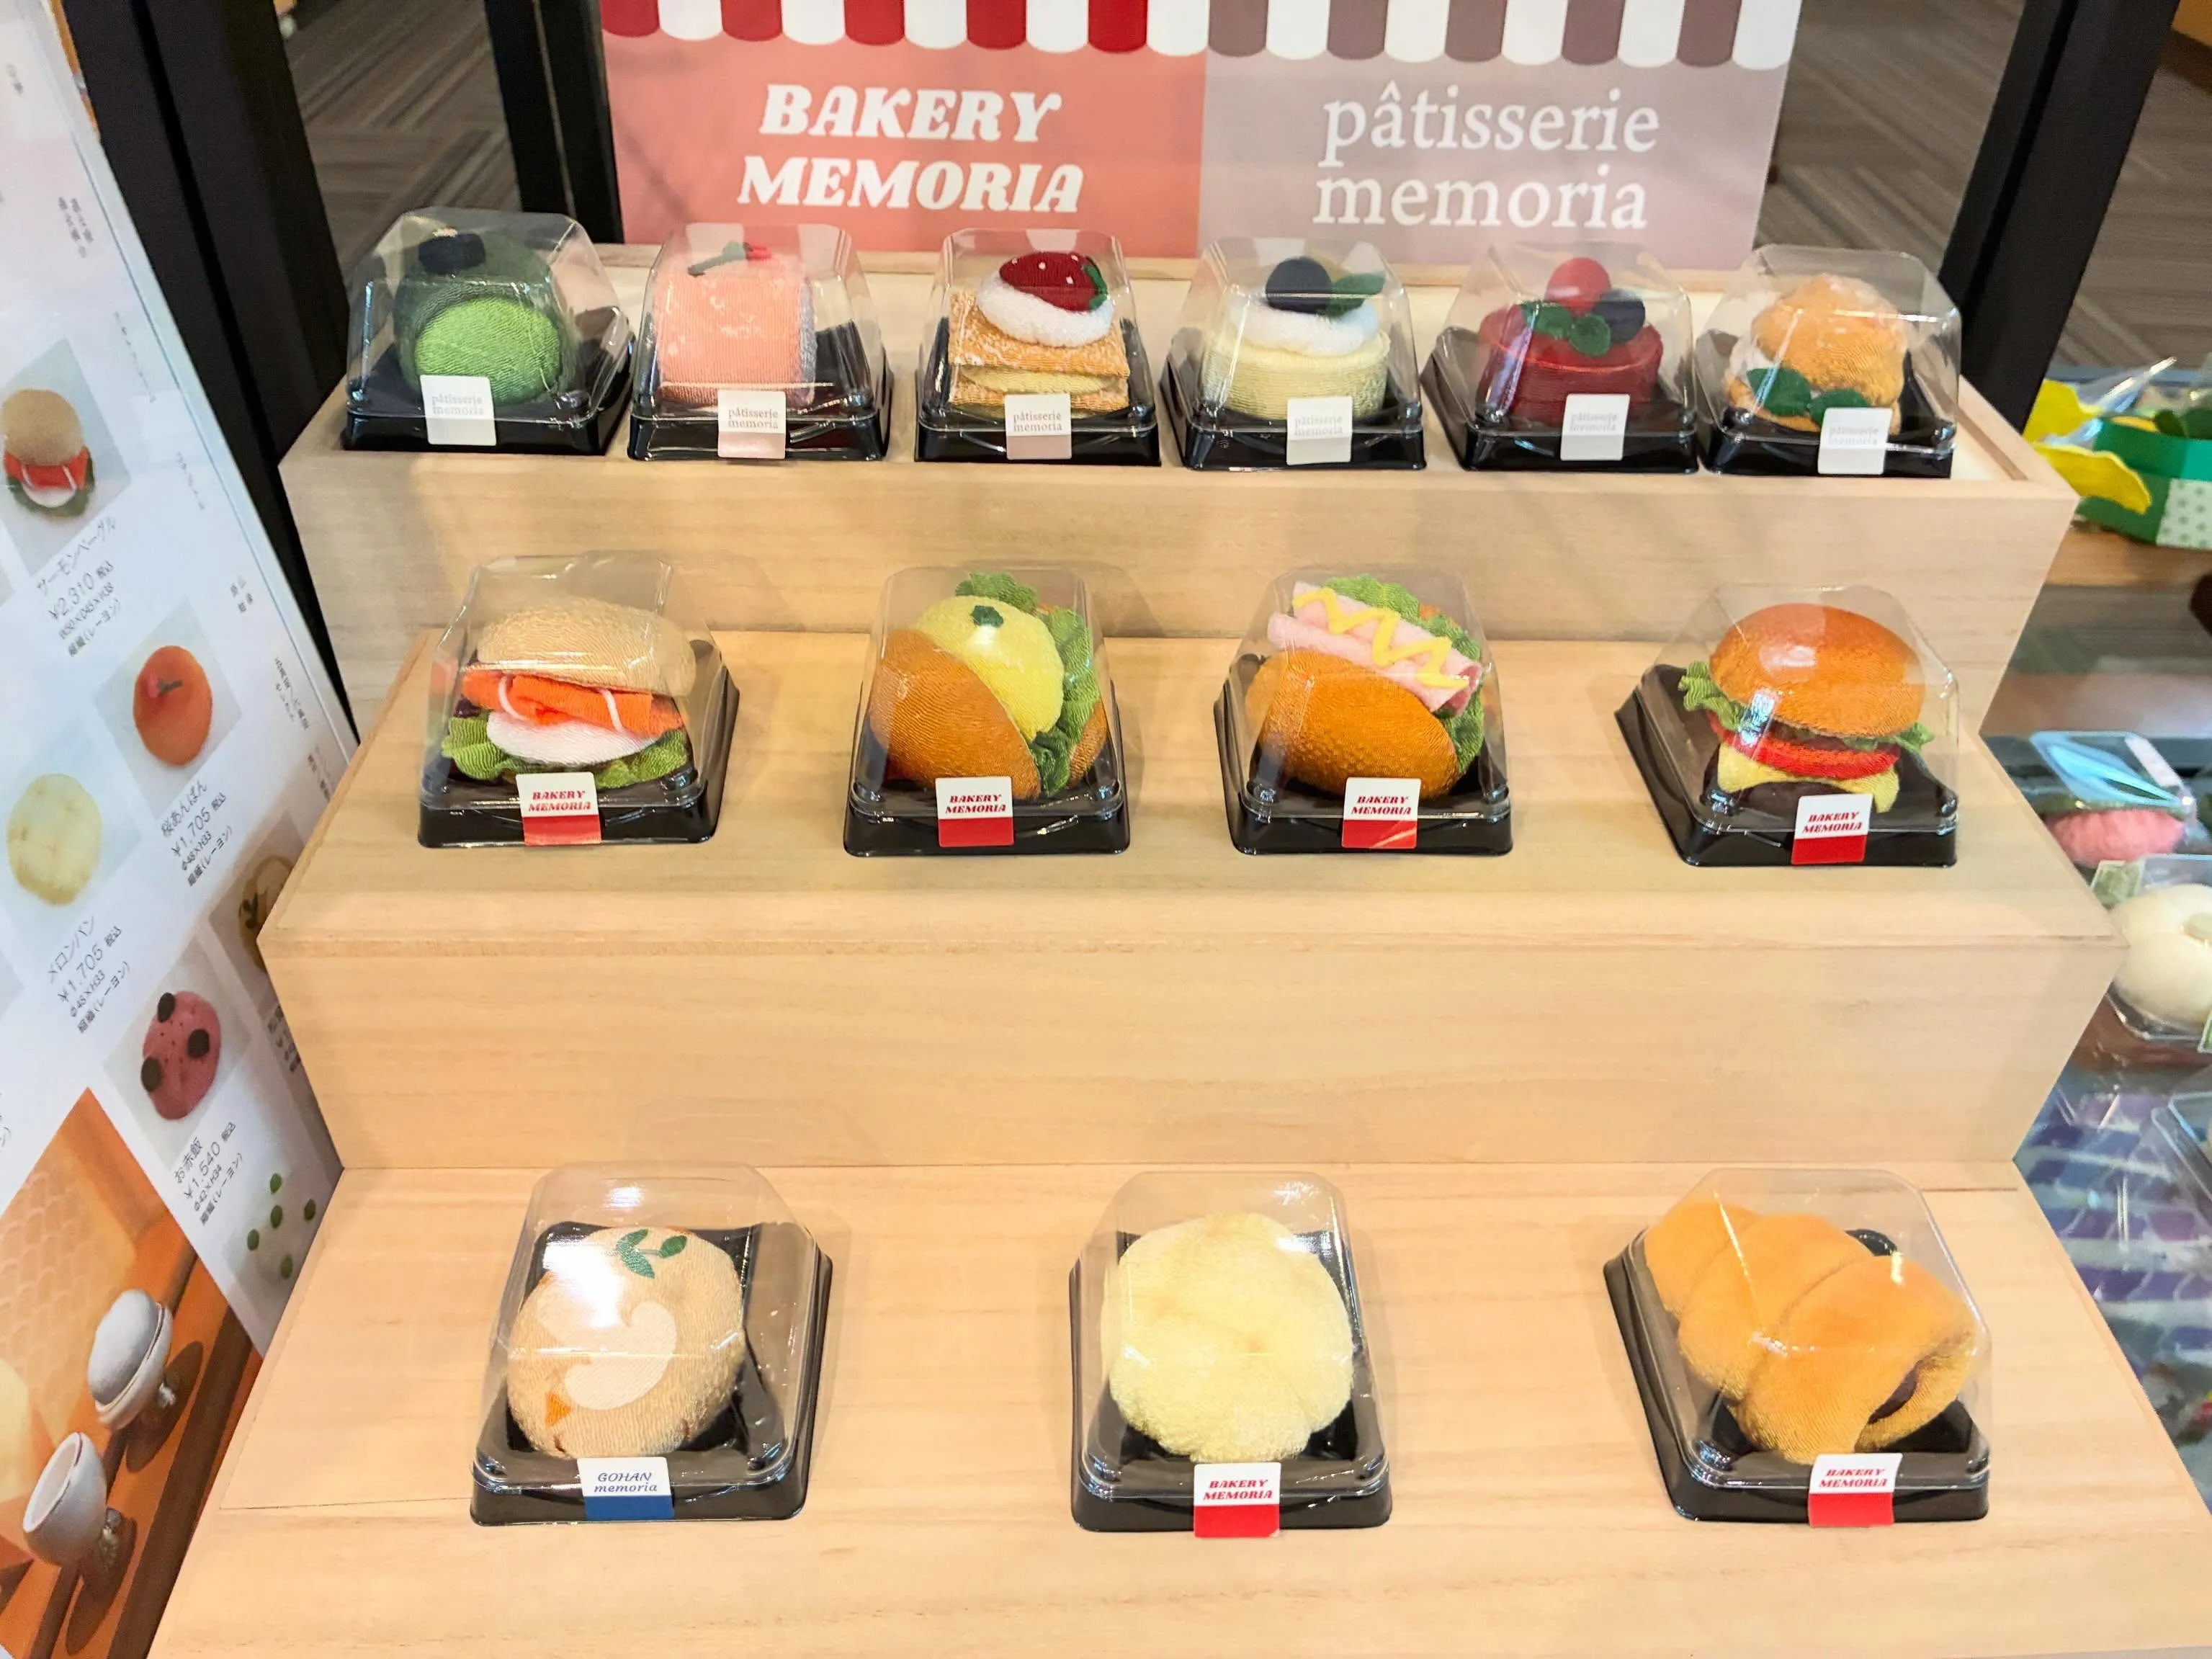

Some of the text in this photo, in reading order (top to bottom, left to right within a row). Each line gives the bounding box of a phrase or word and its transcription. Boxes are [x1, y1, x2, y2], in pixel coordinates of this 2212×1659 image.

[758, 84, 1062, 142] BAKERY
[1317, 79, 1660, 168] pâtisserie
[737, 155, 1084, 213] MEMORIA
[1312, 163, 1648, 229] memoria
[1013, 410, 1062, 423] pâtisserie
[727, 419, 779, 429] memoria
[1013, 421, 1063, 432] memoria
[533, 790, 586, 800] BAKERY
[949, 794, 1002, 803] BAKERY
[1357, 795, 1409, 804] BAKERY
[529, 801, 591, 812] MEMORIA
[946, 804, 1006, 813] MEMORIA
[1351, 806, 1412, 815] MEMORIA
[1809, 812, 1860, 822] BAKERY
[1802, 822, 1863, 833] MEMORIA
[48, 915, 94, 984] メロンパン
[174, 1136, 204, 1184] お赤飯
[598, 1472, 652, 1482] GOHAN
[594, 1482, 657, 1493] memoria
[1209, 1479, 1268, 1488] BAKERY
[1819, 1478, 1888, 1488] MEMORIA
[1203, 1490, 1273, 1501] MEMORIA
